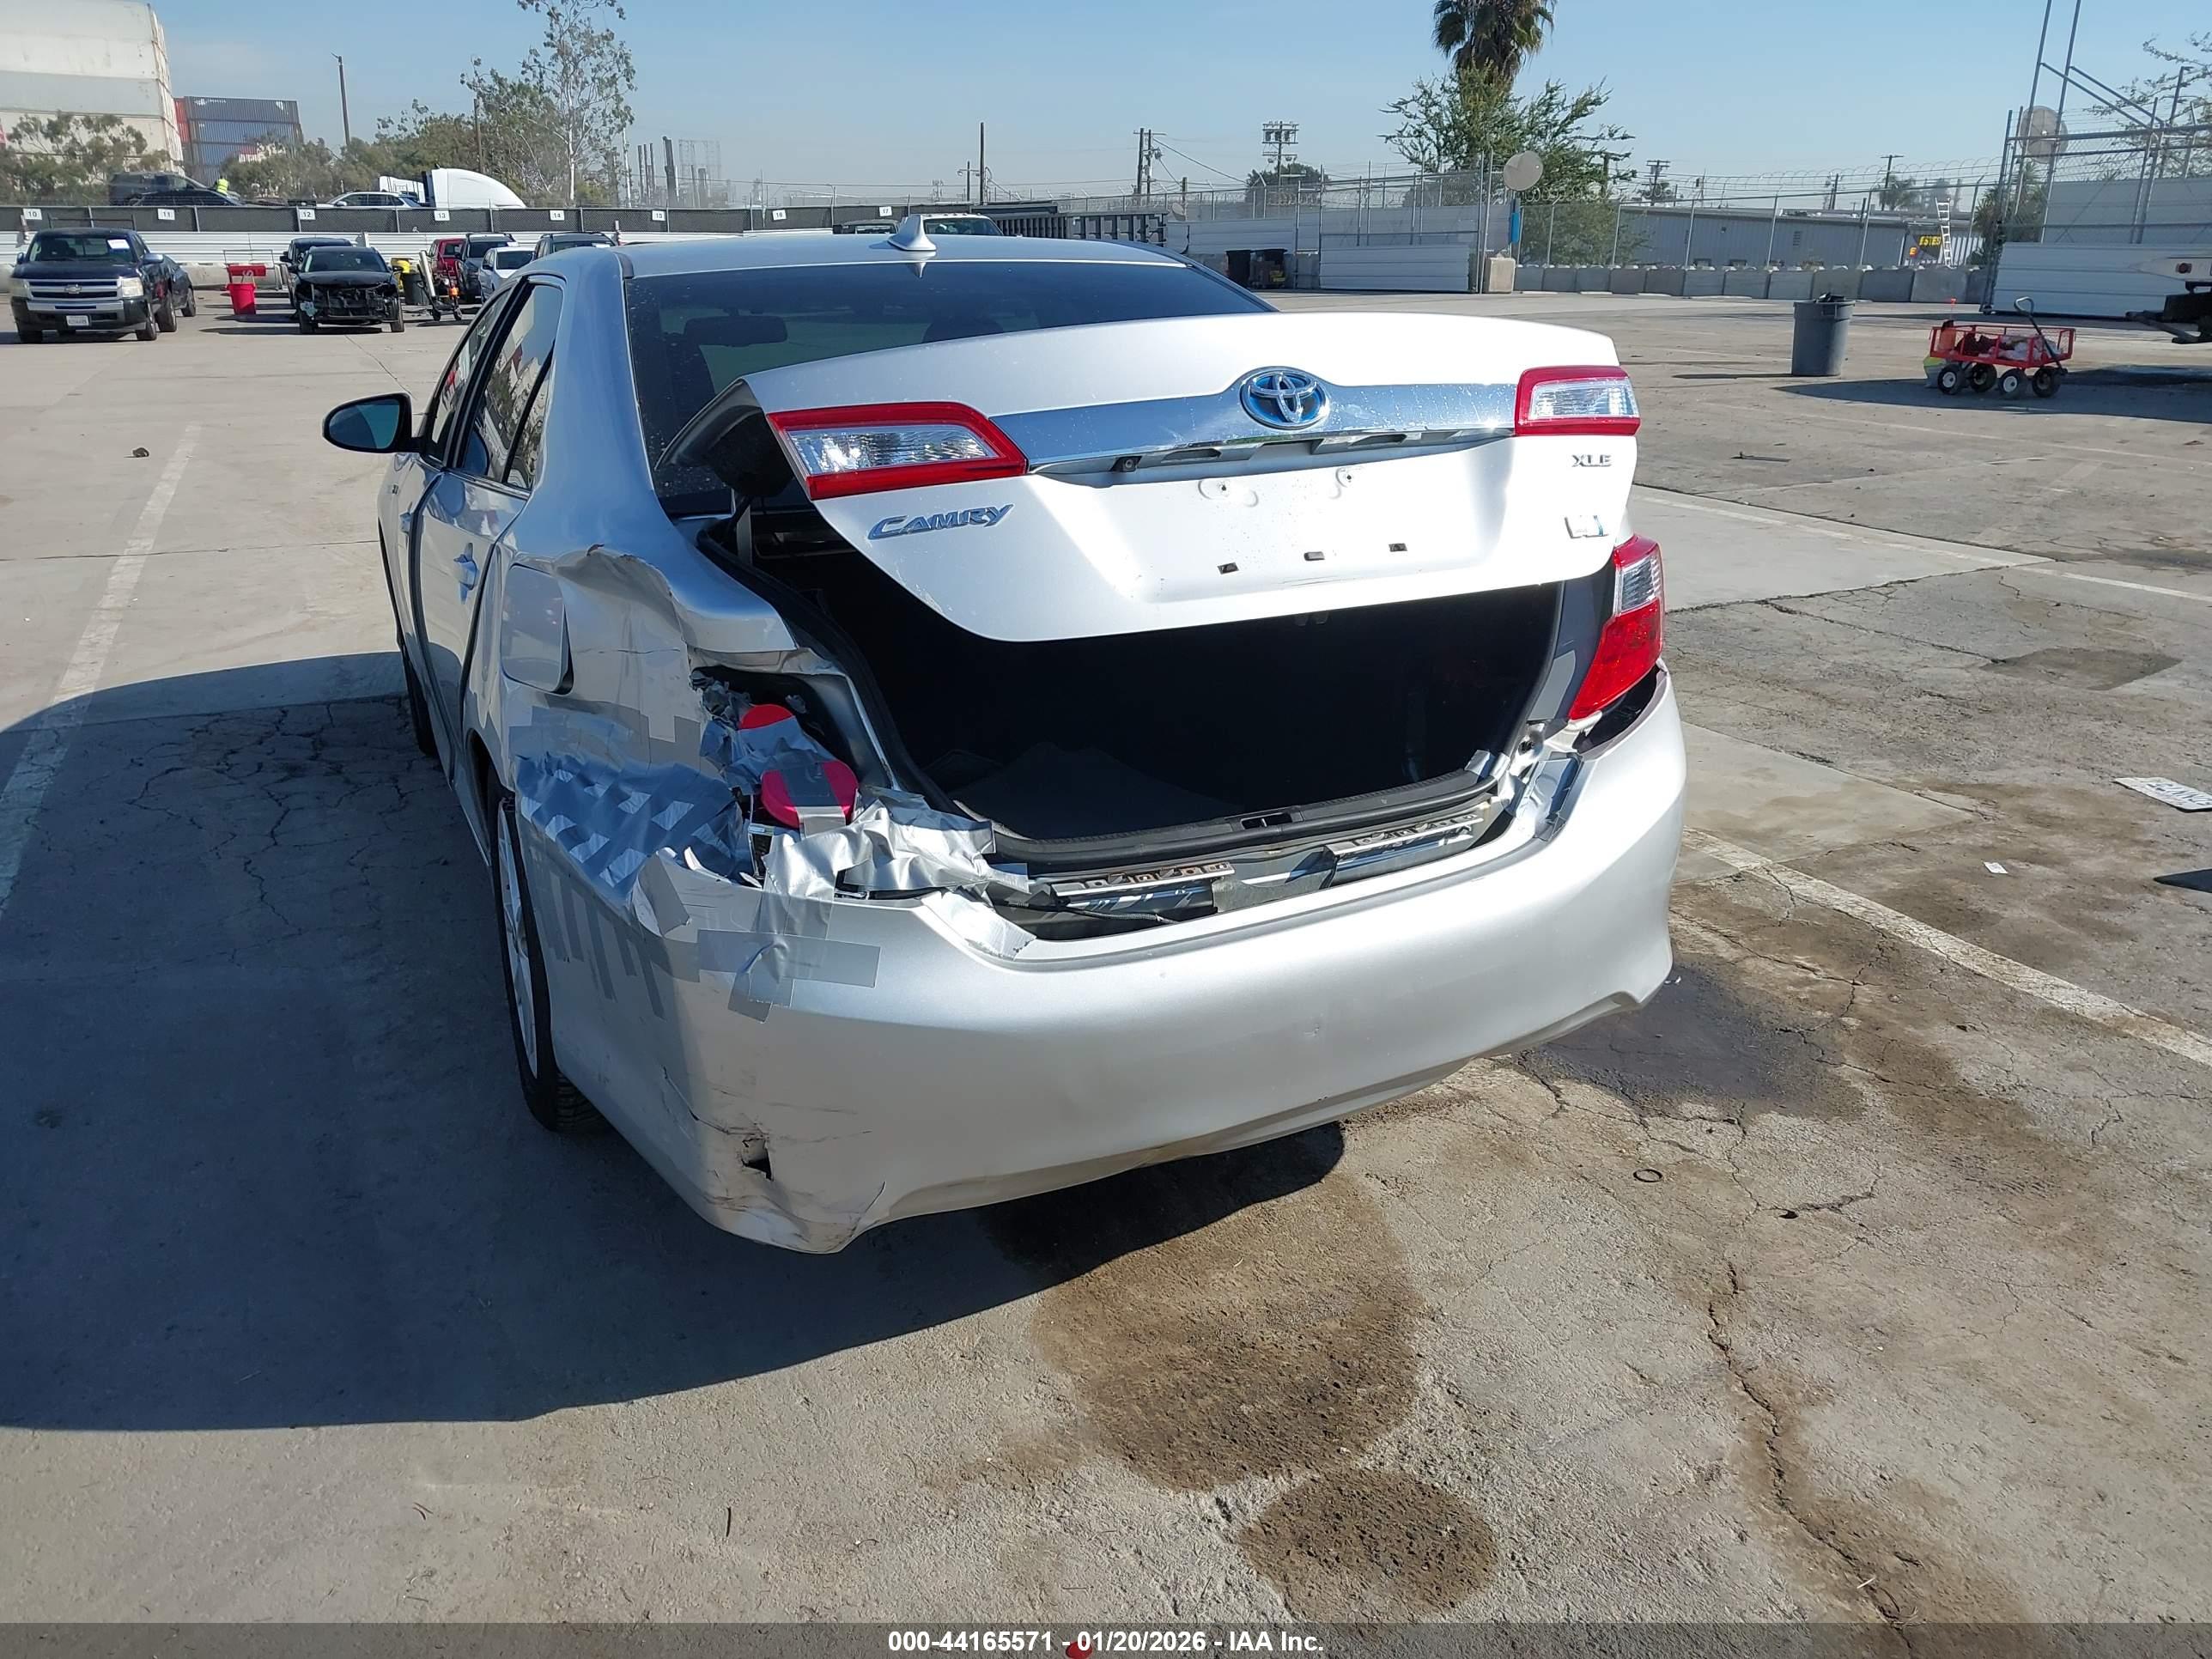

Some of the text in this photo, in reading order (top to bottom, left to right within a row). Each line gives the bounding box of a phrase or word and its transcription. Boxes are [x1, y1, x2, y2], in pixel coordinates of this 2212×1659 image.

[1918, 235, 1942, 246] ESTES
[1571, 454, 1613, 468] XLE
[866, 503, 1015, 540] CAMRY
